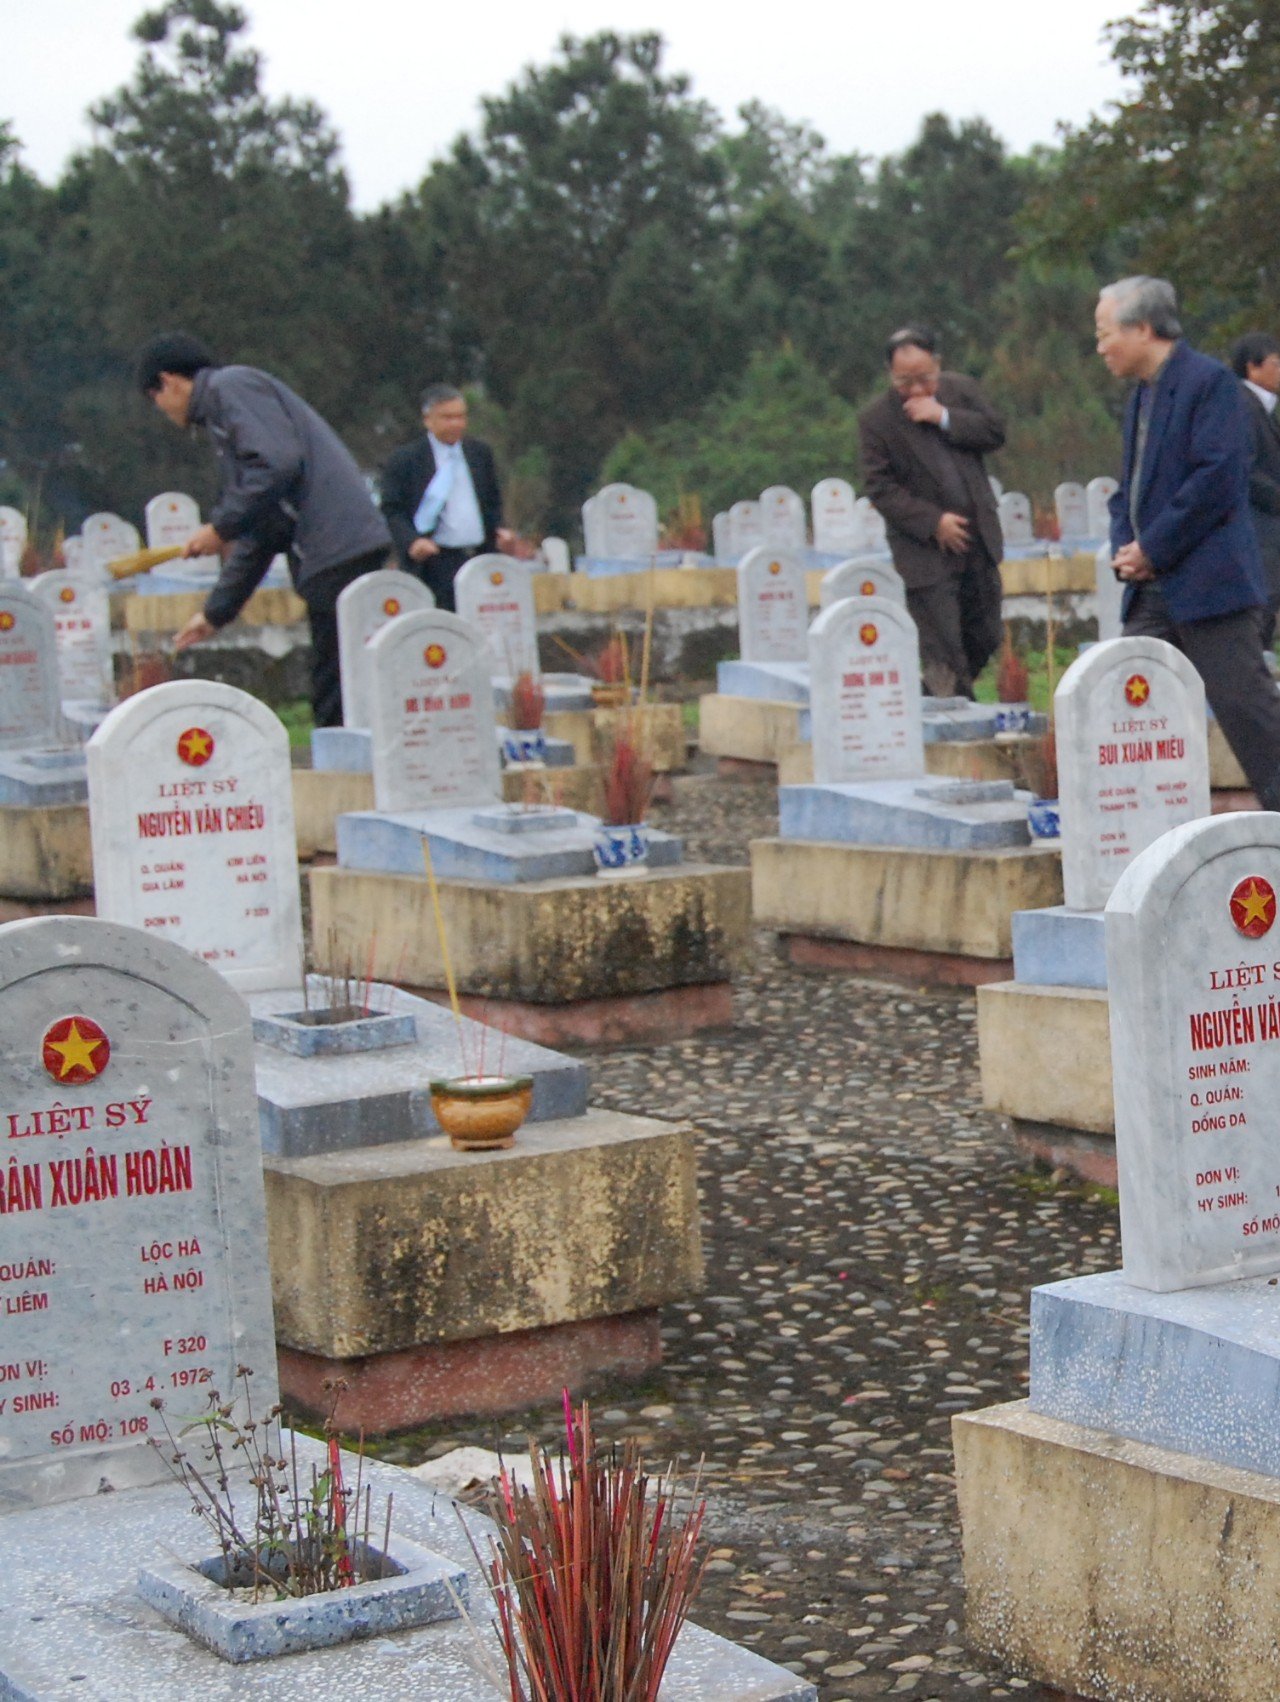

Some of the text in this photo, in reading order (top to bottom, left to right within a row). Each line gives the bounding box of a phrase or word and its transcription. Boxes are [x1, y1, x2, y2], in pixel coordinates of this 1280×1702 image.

[1112, 717, 1146, 734] LIỆT
[159, 778, 206, 798] LIỆT
[1209, 961, 1266, 991] LIỆT
[1190, 993, 1255, 1052] NGUYỄN
[1188, 1064, 1216, 1080] SINH
[1190, 1093, 1203, 1107] Q.
[6, 1101, 94, 1139] LIỆT
[48, 1146, 119, 1208] XUÂN
[125, 1138, 193, 1197] HOÀN
[1198, 1198, 1214, 1213] HY
[1217, 1192, 1249, 1209] SINH:
[1242, 1215, 1259, 1236] SỐ
[141, 1240, 173, 1265] LỘC
[178, 1235, 201, 1257] HÀ
[6, 1267, 203, 1314] LIÊM HÀ NỘI
[163, 1340, 172, 1356] F
[177, 1335, 206, 1354] 320
[13, 1391, 59, 1413] SINH:
[50, 1420, 75, 1446] SỐ
[120, 1416, 149, 1436] 108
